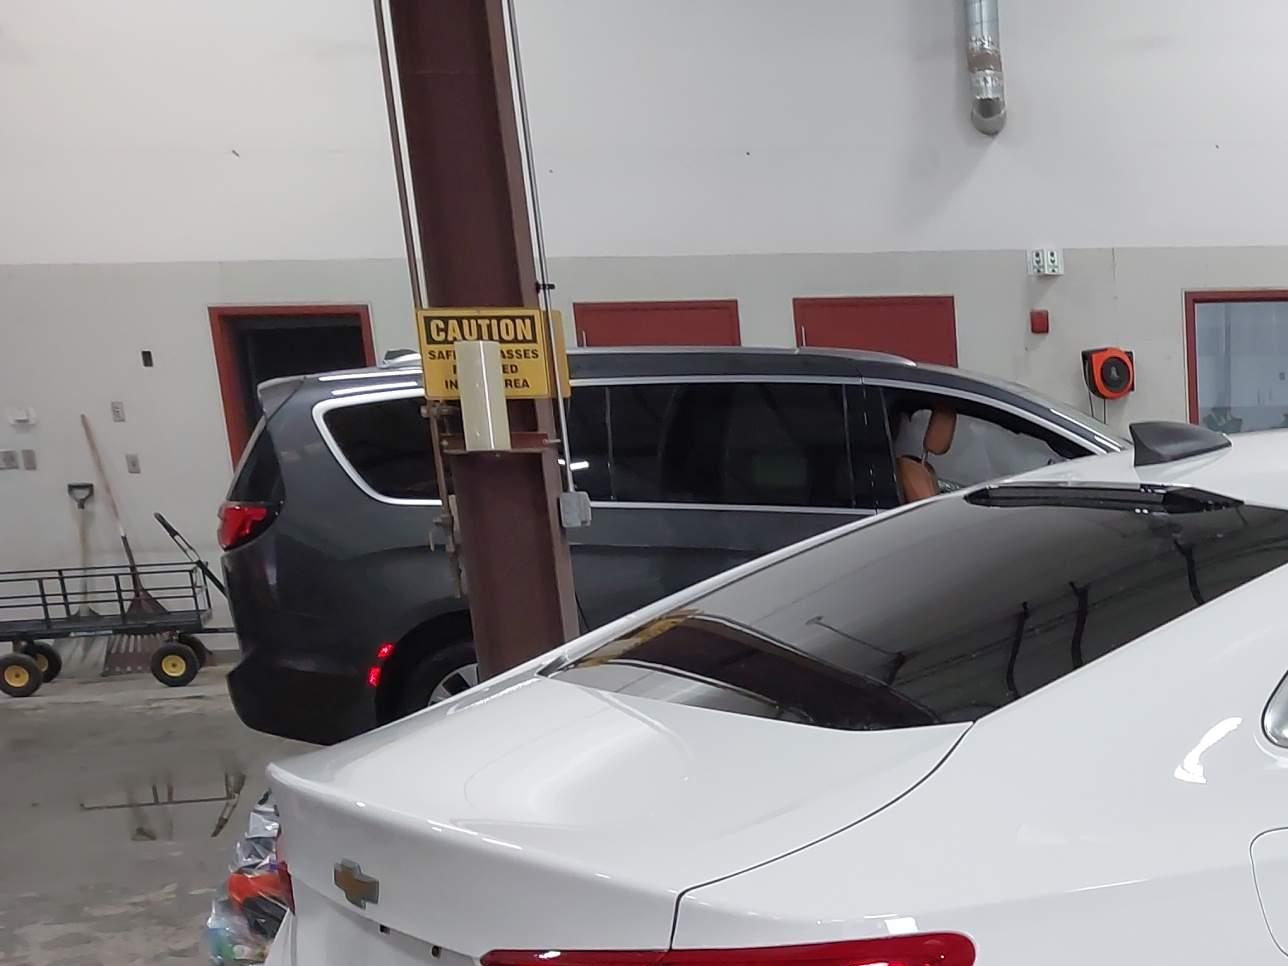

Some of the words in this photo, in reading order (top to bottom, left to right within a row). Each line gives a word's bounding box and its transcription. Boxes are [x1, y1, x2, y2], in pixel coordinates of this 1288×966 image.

[430, 318, 533, 341] CAUTION
[428, 349, 456, 360] SAF
[504, 378, 530, 389] REA
